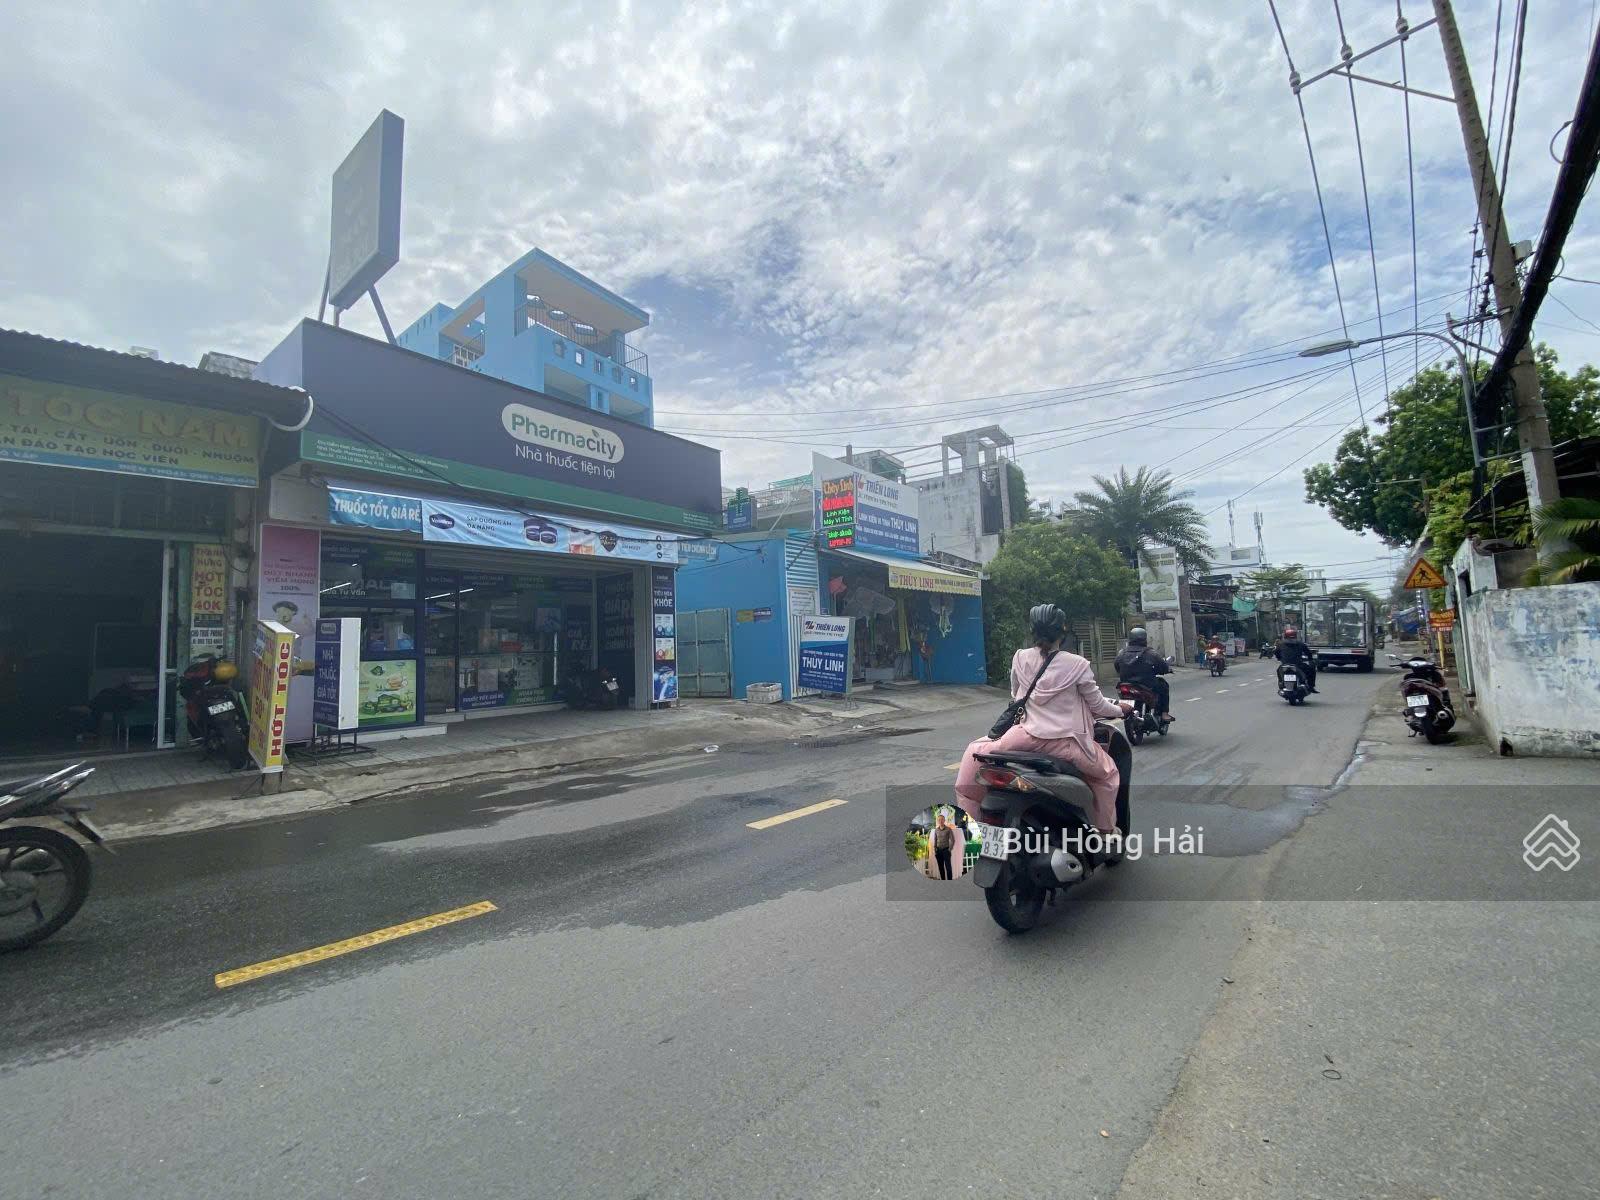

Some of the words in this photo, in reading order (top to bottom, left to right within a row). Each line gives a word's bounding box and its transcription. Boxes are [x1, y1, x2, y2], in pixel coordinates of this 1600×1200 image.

[511, 412, 617, 460] Pharmacity
[515, 444, 542, 462] Nhà
[545, 451, 579, 471] thuốc
[581, 459, 602, 477] tiện
[603, 464, 616, 480] lợi
[334, 495, 368, 516] THUỐC
[390, 502, 408, 520] GIÁ
[194, 600, 221, 610] 40K
[824, 659, 844, 673] LINH
